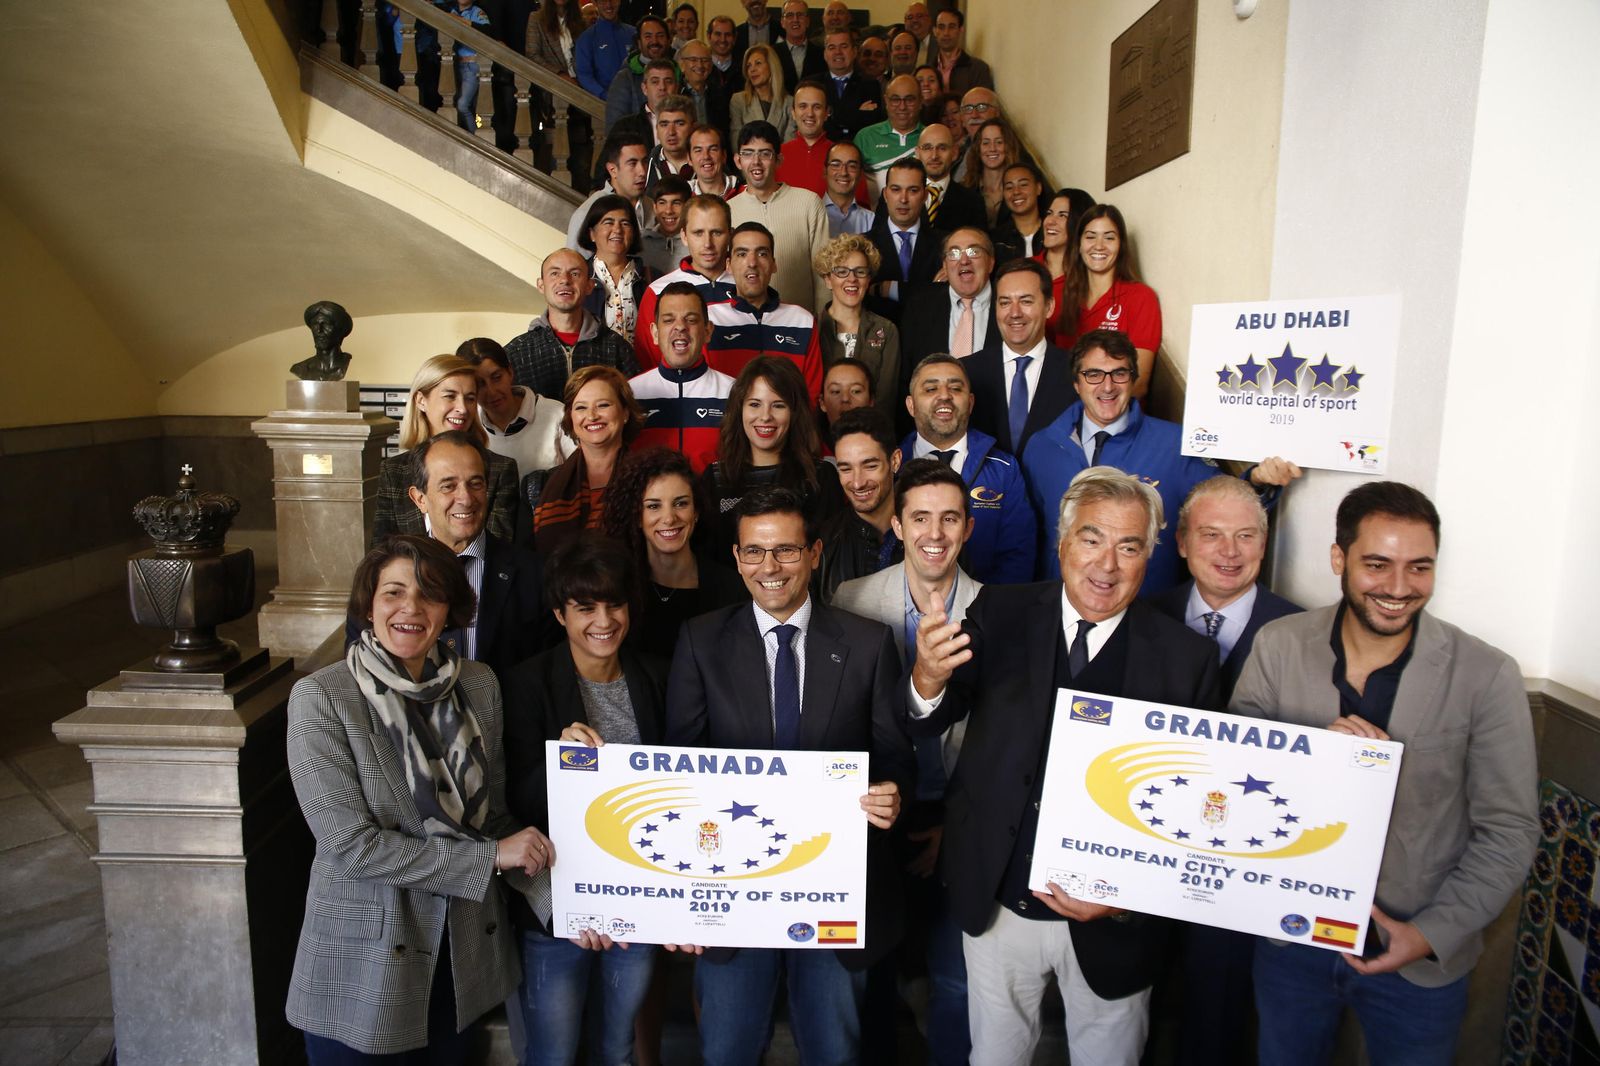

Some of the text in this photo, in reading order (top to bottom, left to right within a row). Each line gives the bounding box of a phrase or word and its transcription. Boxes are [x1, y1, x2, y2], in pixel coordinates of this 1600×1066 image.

[1235, 309, 1350, 330] ABU DHABI
[1218, 392, 1357, 412] world capital of sport
[1269, 413, 1295, 425] 2019
[1195, 433, 1218, 442] aces
[1144, 710, 1312, 755] GRANADA
[1361, 749, 1390, 760] aces
[628, 751, 788, 776] GRANADA
[831, 762, 858, 770] aces
[1186, 852, 1226, 864] CANDIDATE
[1061, 837, 1357, 902] EUROPEAN CITY OF SPORT
[1094, 883, 1119, 893] aces
[1179, 872, 1224, 890] 2019
[574, 882, 849, 903] EUROPEAN CITY OF SPORT
[689, 901, 731, 913] 2019
